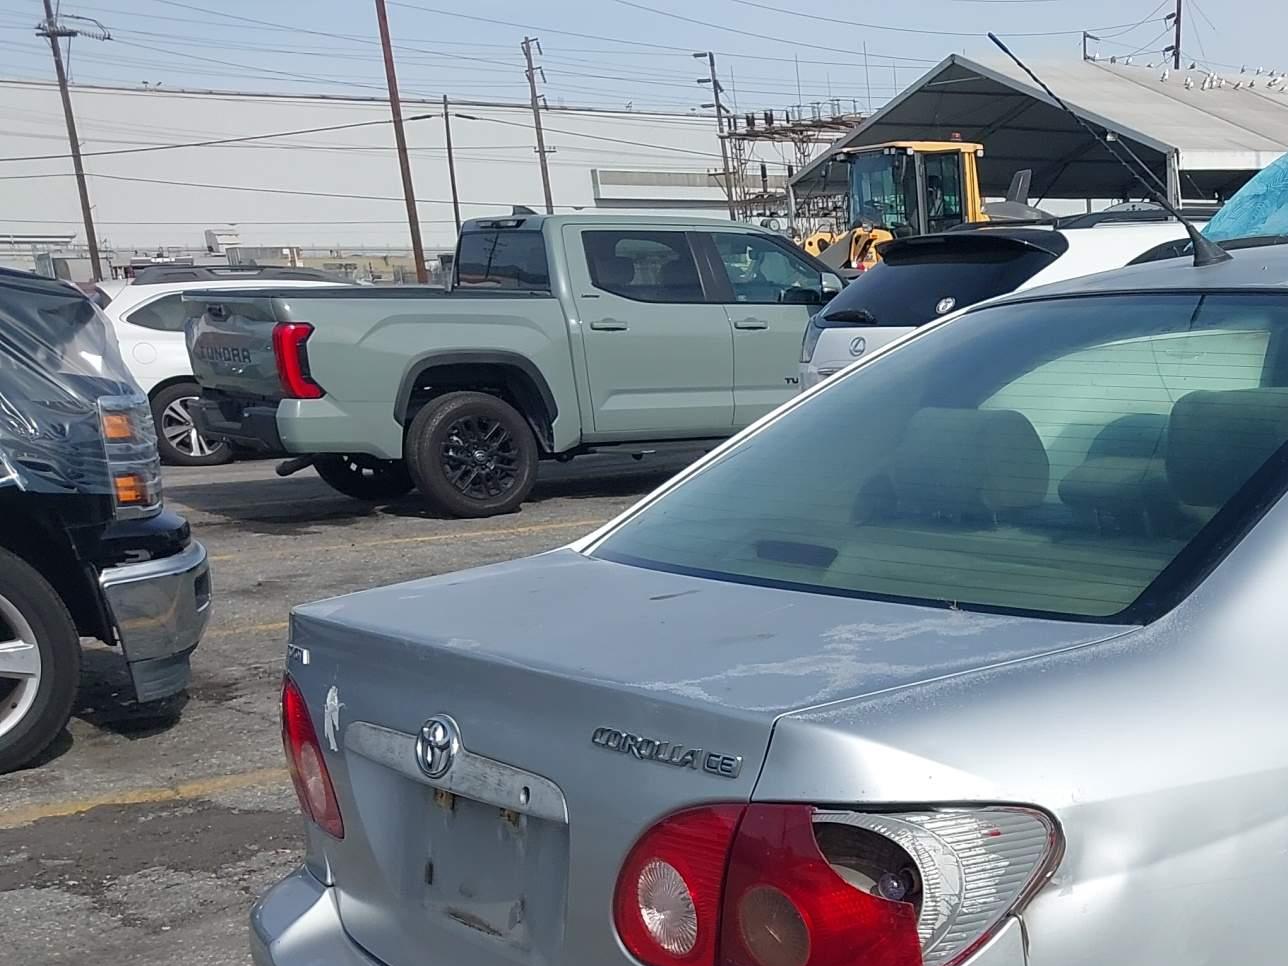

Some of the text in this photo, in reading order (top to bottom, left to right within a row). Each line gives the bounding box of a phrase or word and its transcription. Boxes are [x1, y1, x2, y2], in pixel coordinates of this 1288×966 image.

[200, 345, 252, 363] TUNDRA
[592, 727, 738, 776] COROLLA CE
